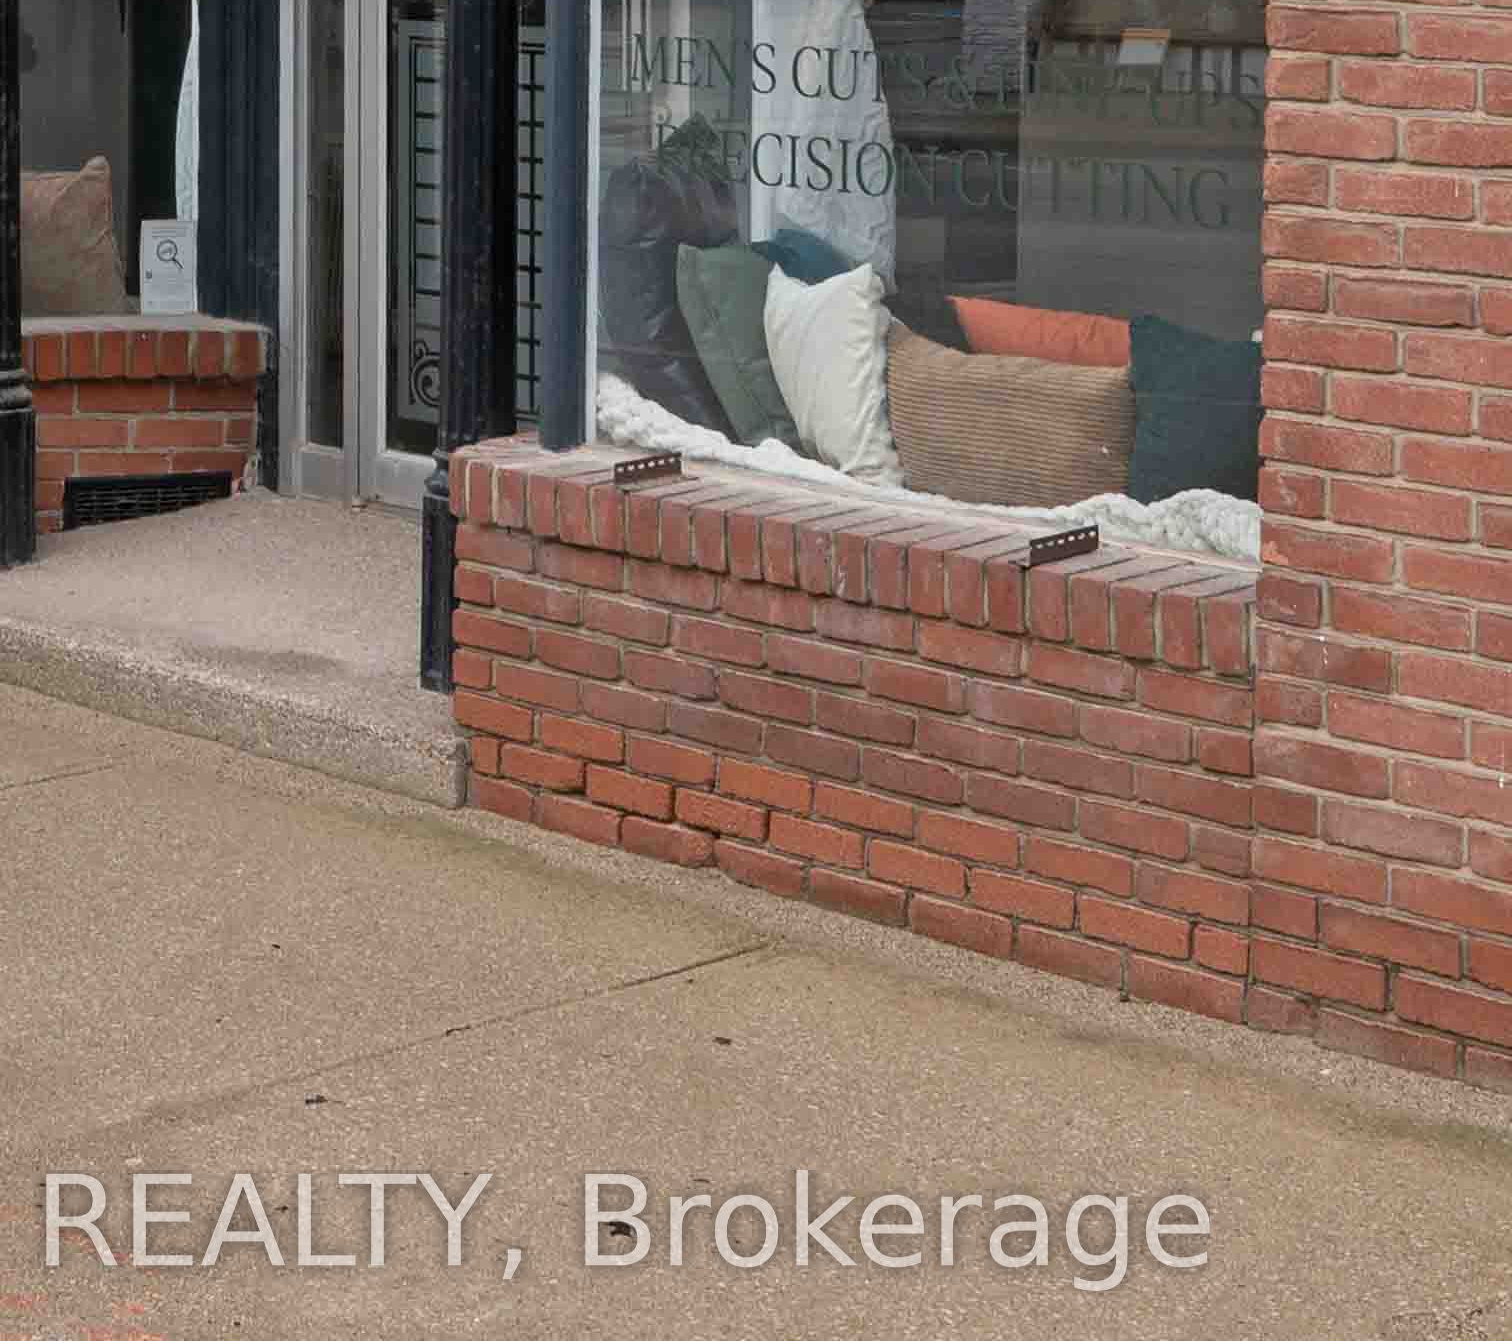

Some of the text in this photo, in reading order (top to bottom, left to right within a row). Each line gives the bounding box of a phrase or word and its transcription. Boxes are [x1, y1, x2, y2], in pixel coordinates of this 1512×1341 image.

[631, 34, 777, 95] MEN'S
[792, 45, 930, 107] CUTS
[653, 123, 1229, 229] PRECISION CUTTING
